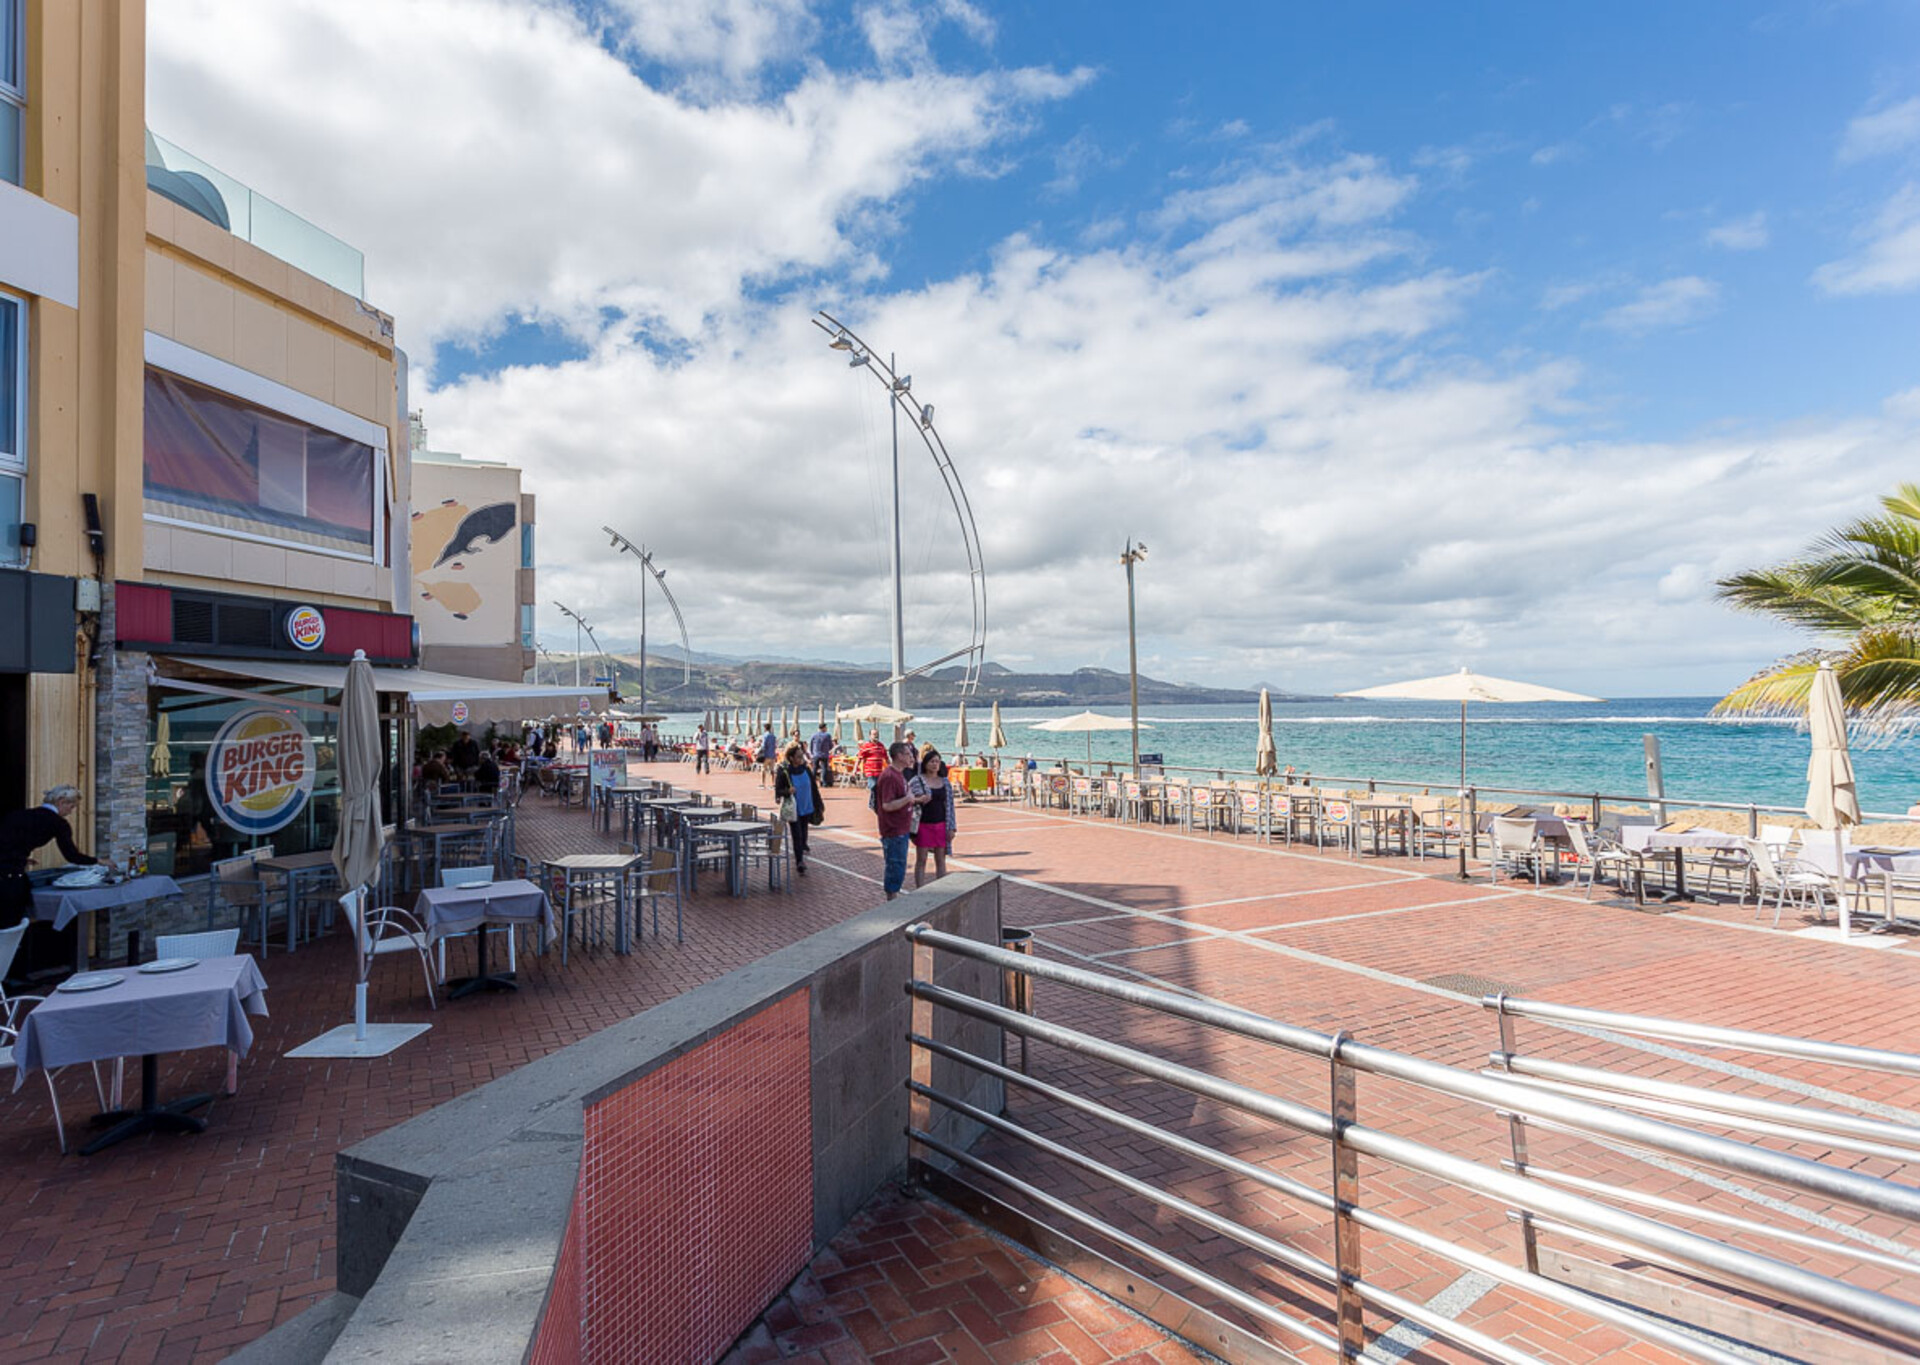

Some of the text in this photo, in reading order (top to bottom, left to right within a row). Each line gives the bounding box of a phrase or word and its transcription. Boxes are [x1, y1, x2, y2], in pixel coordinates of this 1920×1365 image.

[295, 622, 320, 639] KING
[223, 733, 303, 772] BURGER
[224, 753, 305, 804] KING
